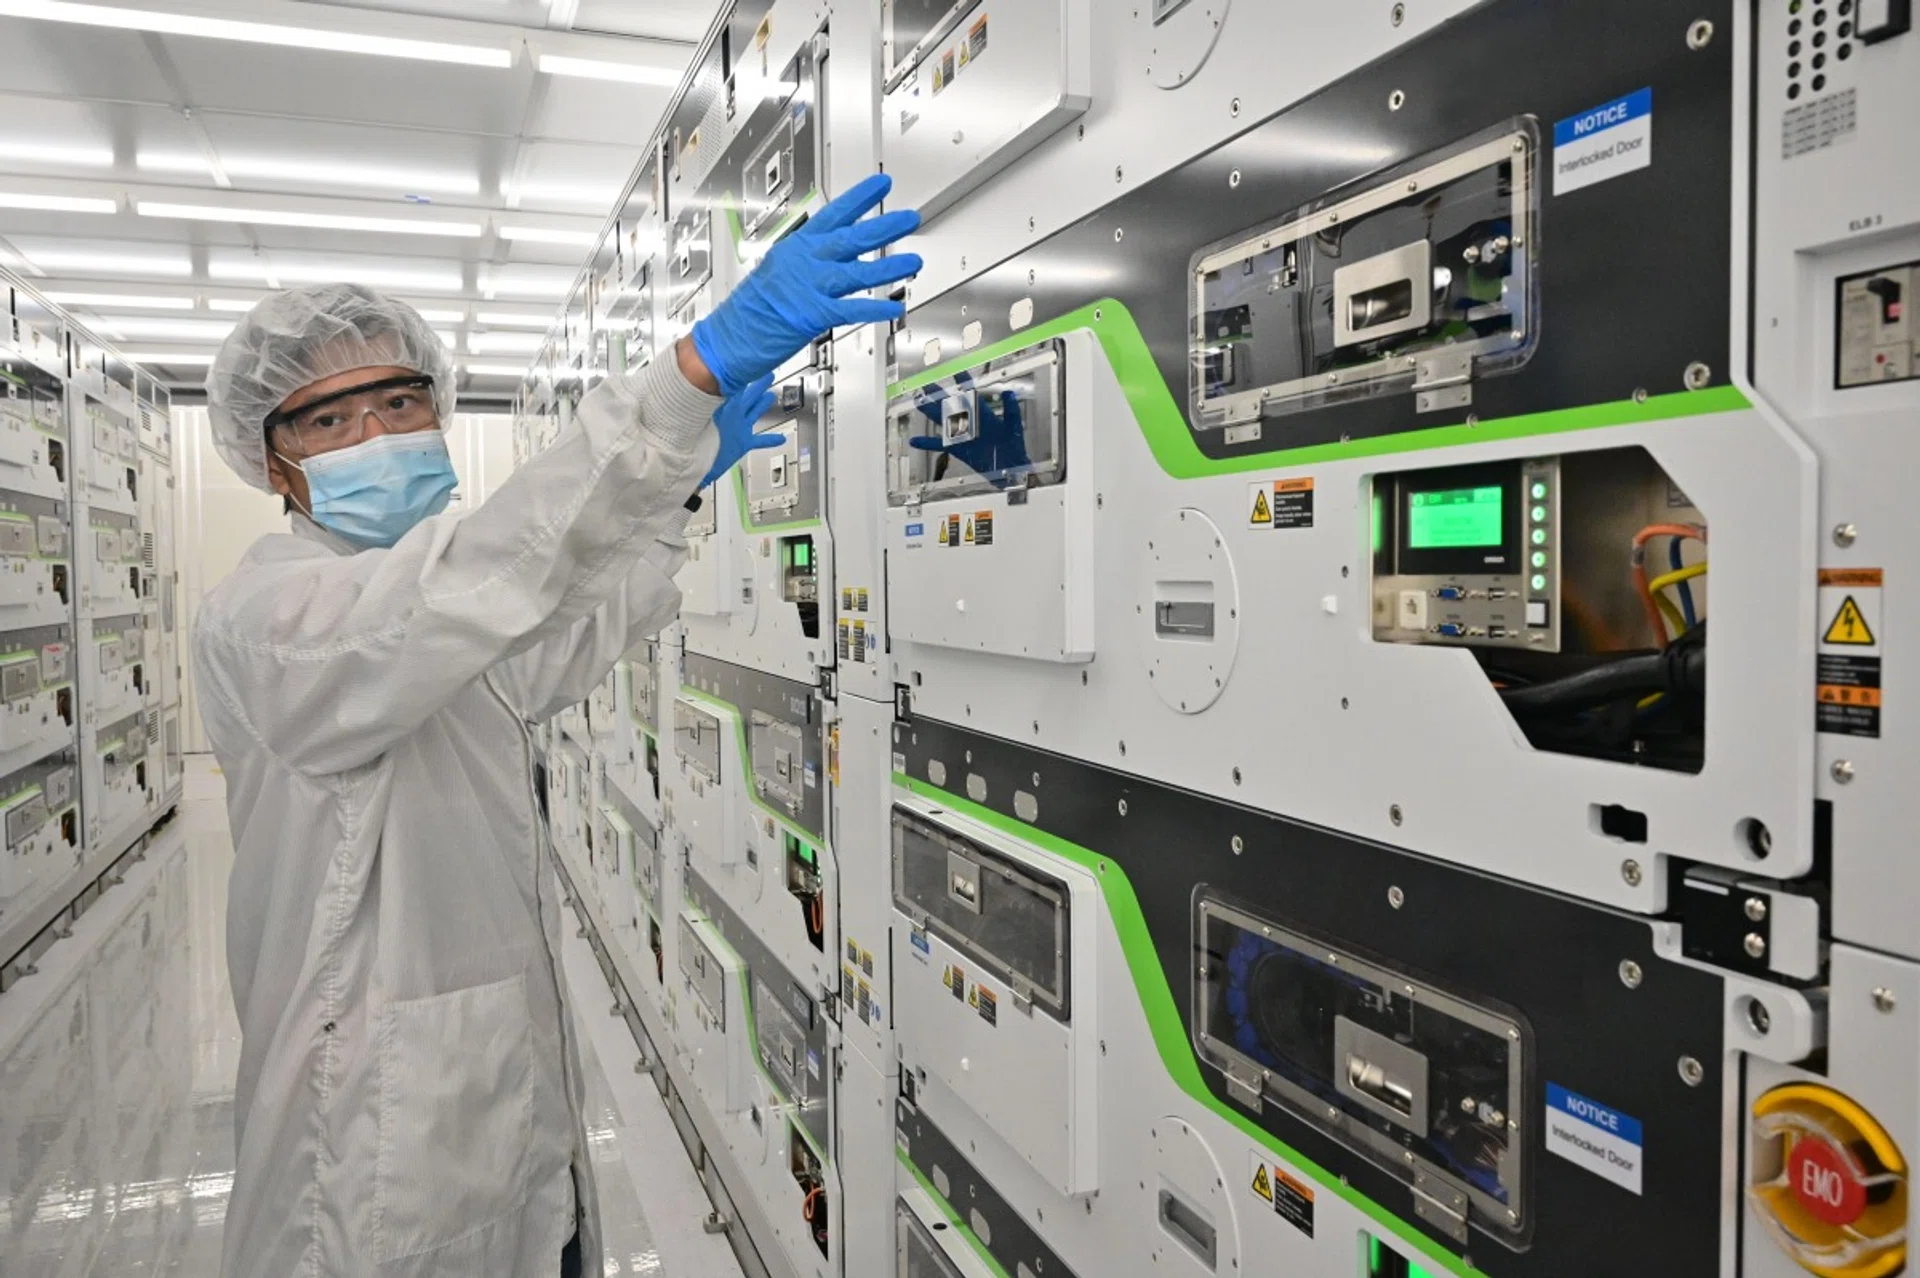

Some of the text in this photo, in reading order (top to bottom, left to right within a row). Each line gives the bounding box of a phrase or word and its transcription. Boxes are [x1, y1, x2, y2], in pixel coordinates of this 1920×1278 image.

[1574, 102, 1628, 136] NOTICE
[1559, 136, 1644, 174] Interlocked Door
[1566, 1095, 1619, 1131] NOTICE
[1552, 1123, 1634, 1172] Interlocked Door
[1803, 1158, 1843, 1208] EMO
